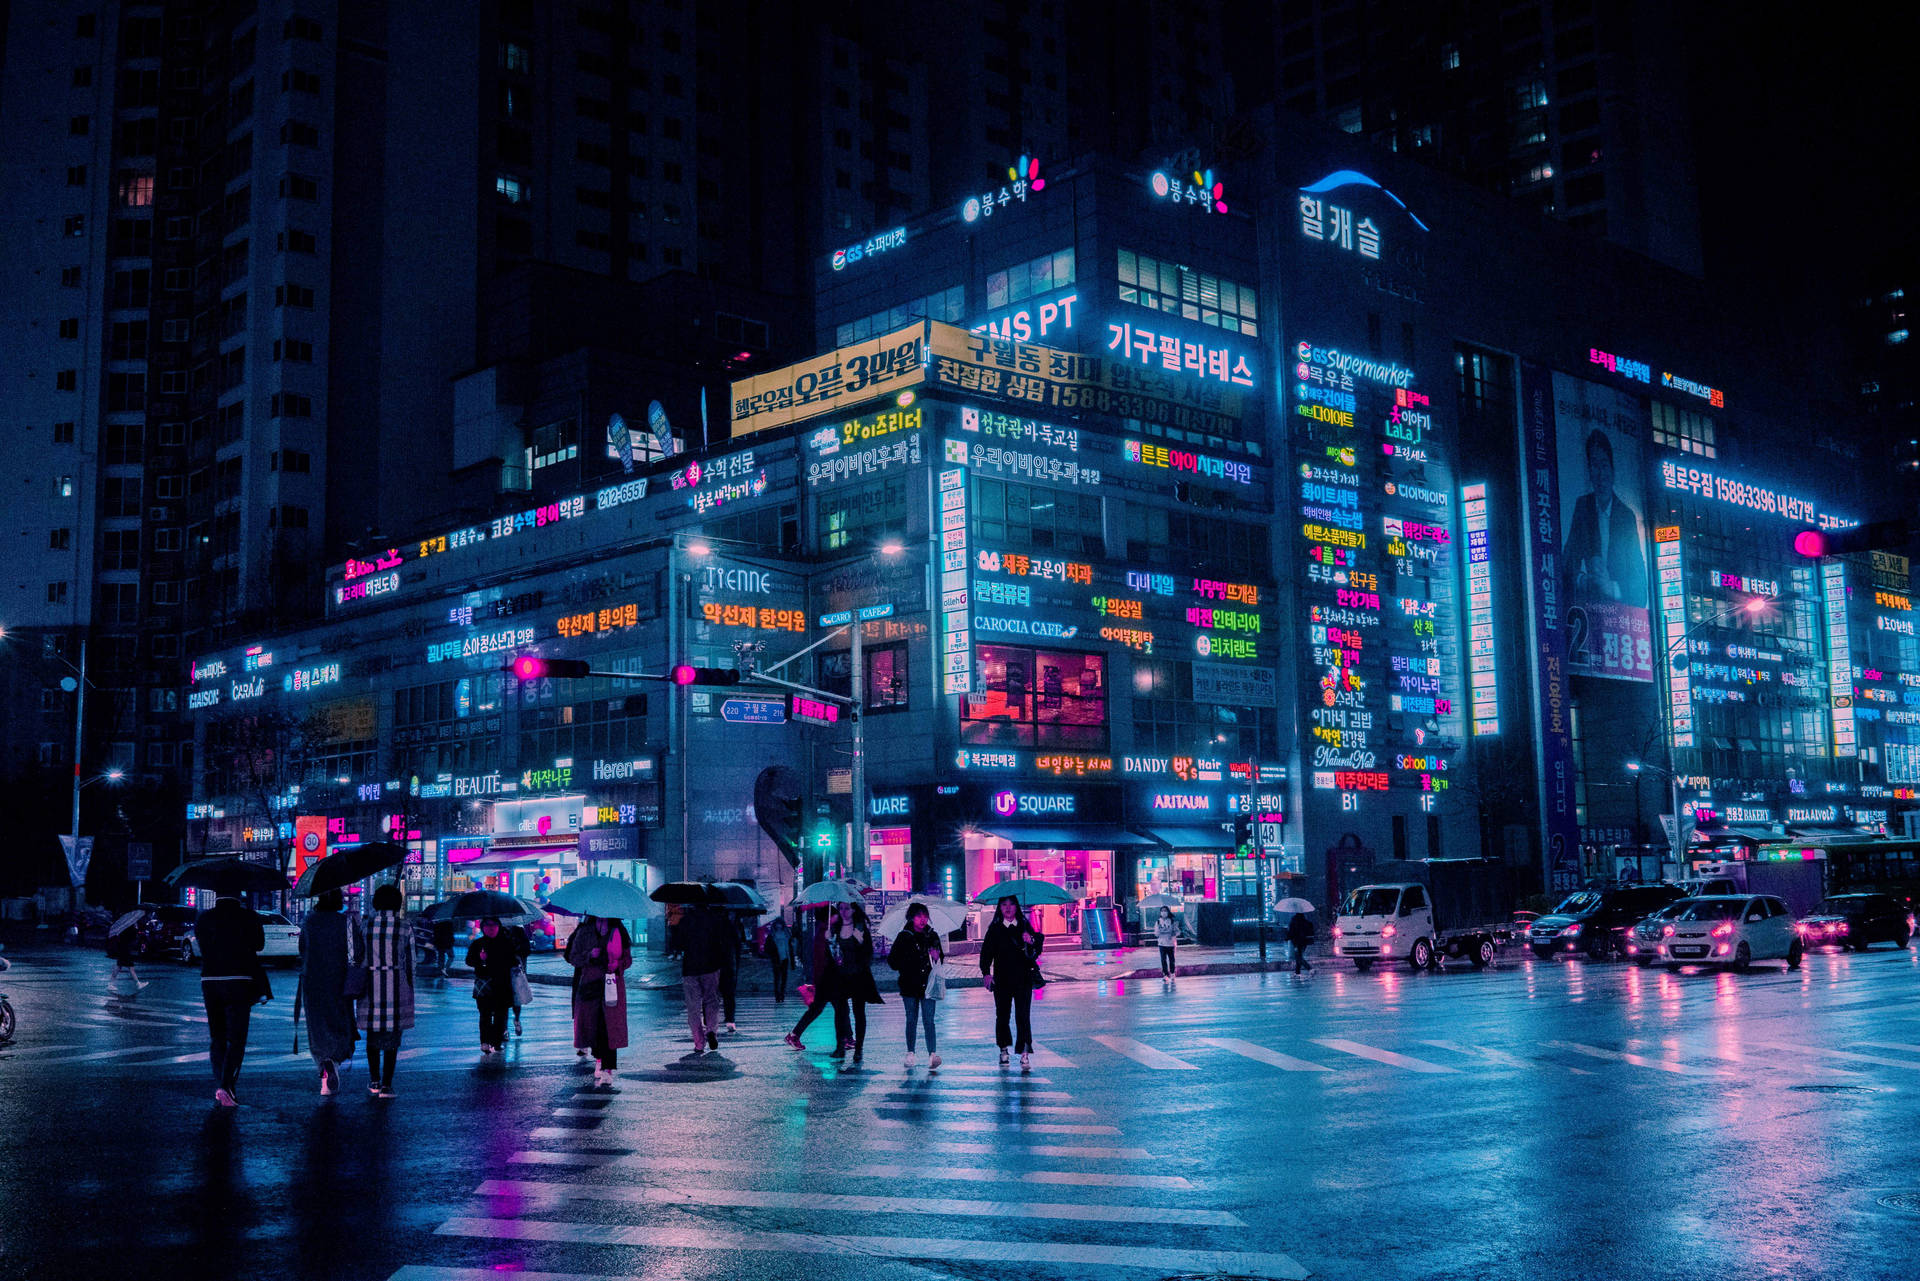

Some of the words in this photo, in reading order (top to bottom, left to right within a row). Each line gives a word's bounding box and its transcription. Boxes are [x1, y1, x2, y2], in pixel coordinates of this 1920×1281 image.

[1299, 196, 1380, 261] 힐캐슬
[865, 226, 907, 258] 수퍼마켓
[1040, 295, 1077, 337] PT
[1108, 322, 1254, 387] 기구필라테스
[937, 357, 1000, 393] 친절한
[1006, 373, 1045, 402] 상담
[1327, 350, 1414, 389] Supermarket
[598, 480, 648, 510] 212-6557
[1662, 461, 1714, 499] 헬로우짐
[1715, 476, 1773, 513] 1588-3396
[862, 607, 882, 618] CAFE
[974, 616, 1029, 635] CAROCIA
[1031, 620, 1064, 637] CAFE
[1312, 708, 1346, 729] 이가네
[1350, 711, 1372, 729] 김밥
[593, 759, 634, 780] Heren
[1124, 757, 1168, 773] DANDY
[873, 797, 910, 815] UARE
[1019, 795, 1075, 815] SQUARE
[1153, 795, 1209, 810] ARITAUM
[1240, 794, 1282, 812] 장백이
[1341, 792, 1358, 811] B1
[1420, 795, 1434, 812] 1F
